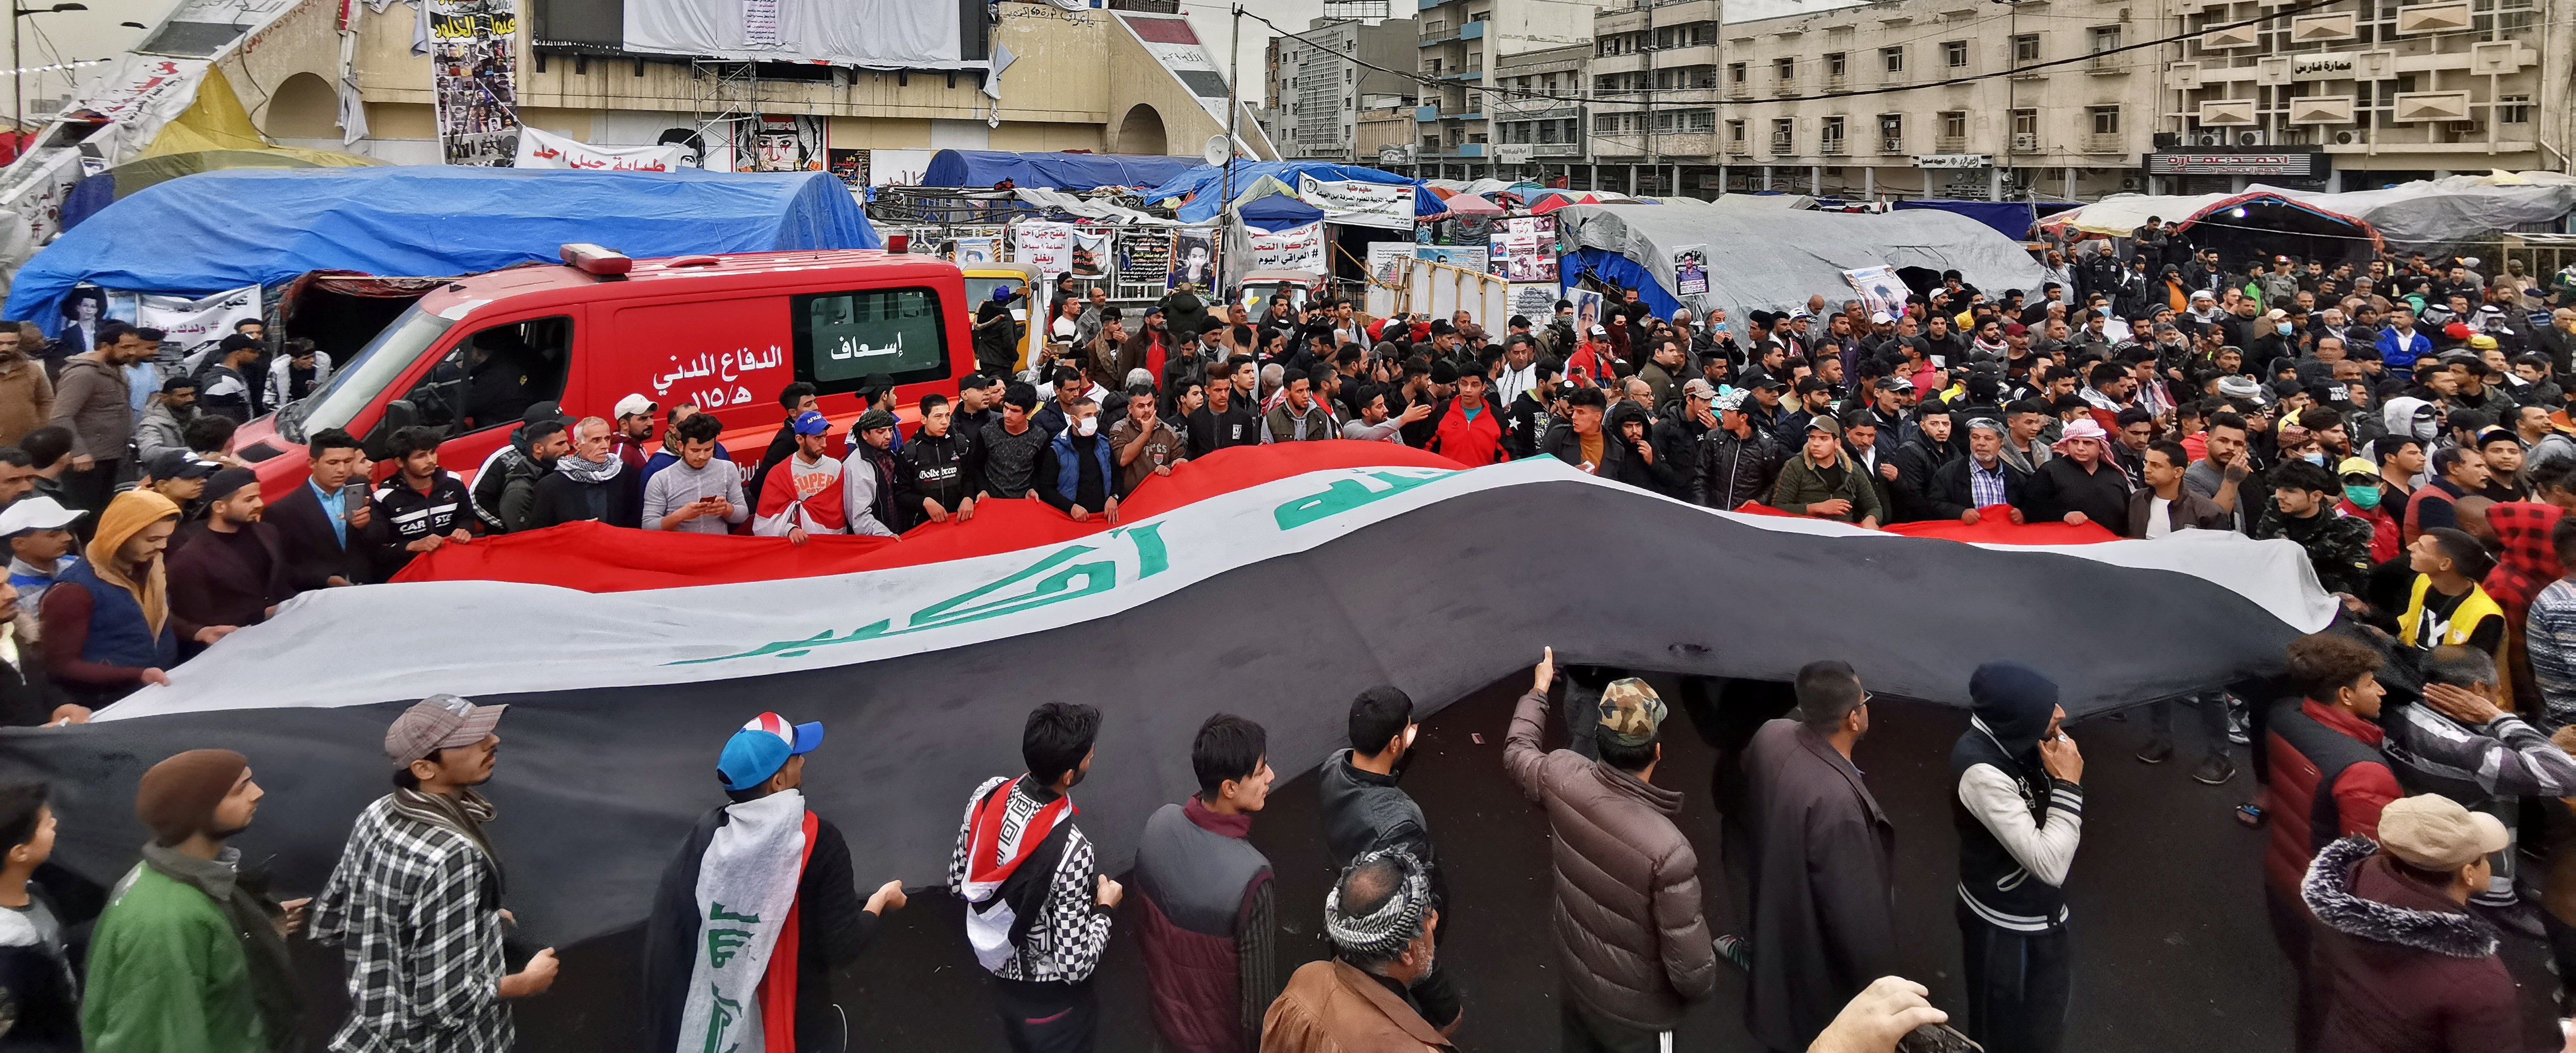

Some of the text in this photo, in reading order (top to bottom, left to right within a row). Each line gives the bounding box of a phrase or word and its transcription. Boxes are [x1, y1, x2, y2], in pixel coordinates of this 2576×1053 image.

[435, 12, 515, 41] عنوا الخلود
[2295, 61, 2352, 74] عمارة فارس
[1035, 230, 1049, 239] جبل
[1050, 230, 1066, 240] يفتح
[1032, 253, 1054, 264] ويغلق
[1259, 255, 1279, 266] اليوم
[1281, 251, 1310, 264] العراقي
[831, 331, 904, 360] إسعاف
[653, 344, 782, 396] الدفاع المدني
[399, 520, 427, 532] CAR
